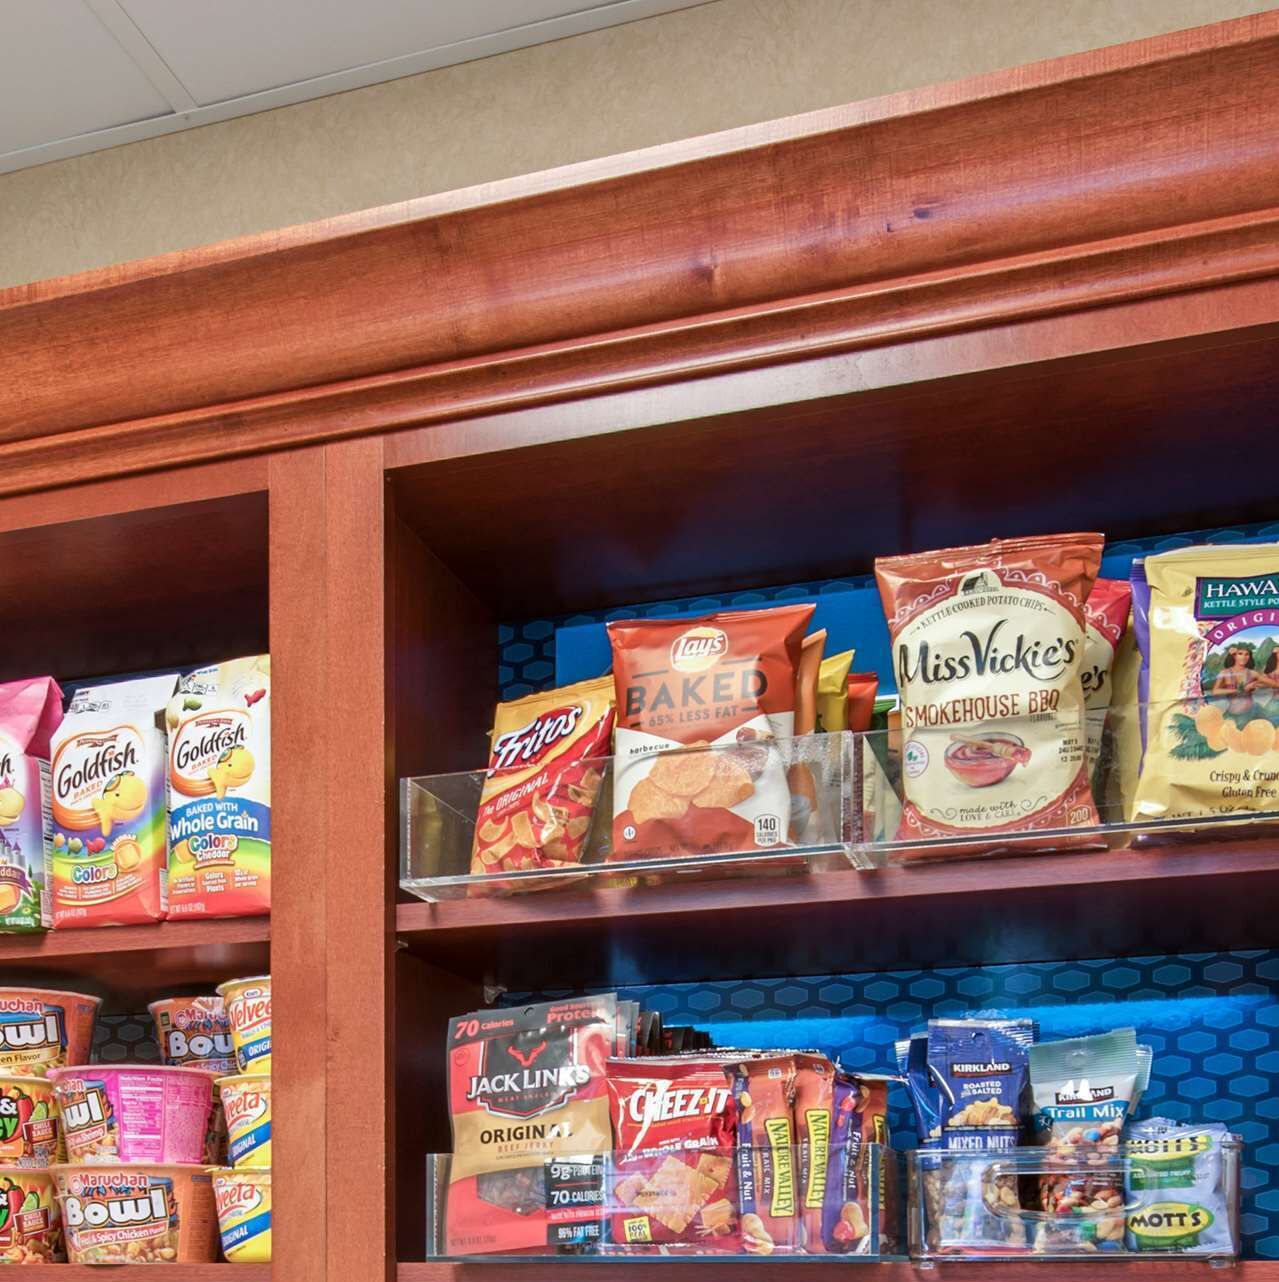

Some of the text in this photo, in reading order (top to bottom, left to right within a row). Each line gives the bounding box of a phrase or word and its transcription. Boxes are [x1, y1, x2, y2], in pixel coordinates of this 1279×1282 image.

[920, 595, 1045, 630] KETTLE COOKED POTATO CHIPS
[1204, 599, 1236, 609] KETTLE
[1238, 598, 1265, 607] STYLE
[900, 640, 970, 689] Miss
[960, 618, 1076, 682] Vickie's
[626, 669, 768, 717] BAKED
[648, 706, 738, 728] 65% LESS FAT
[906, 687, 1061, 729] SMOKEHOUSE BBQ
[177, 722, 245, 770] Goldfish
[487, 706, 582, 779] Fritos
[57, 739, 136, 799] Goldfish
[1222, 787, 1277, 798] Gluten Free
[186, 802, 239, 817] BAKED WITH
[960, 801, 1017, 814] made with
[1070, 808, 1089, 825] 200
[170, 811, 259, 841] Whole Grain
[758, 817, 776, 831] 140
[953, 1061, 1011, 1074] KIRKLAND
[963, 1080, 1002, 1090] ROASTED
[972, 1087, 1003, 1096] SALTED
[0, 1098, 19, 1116] &
[1048, 1106, 1125, 1119] Trail Mix
[741, 1142, 752, 1168] Fruit
[81, 1174, 148, 1188] Maruchan
[744, 1180, 753, 1200] Nut
[67, 1187, 166, 1226] Bowl
[1130, 1212, 1202, 1228] MOTT'S
